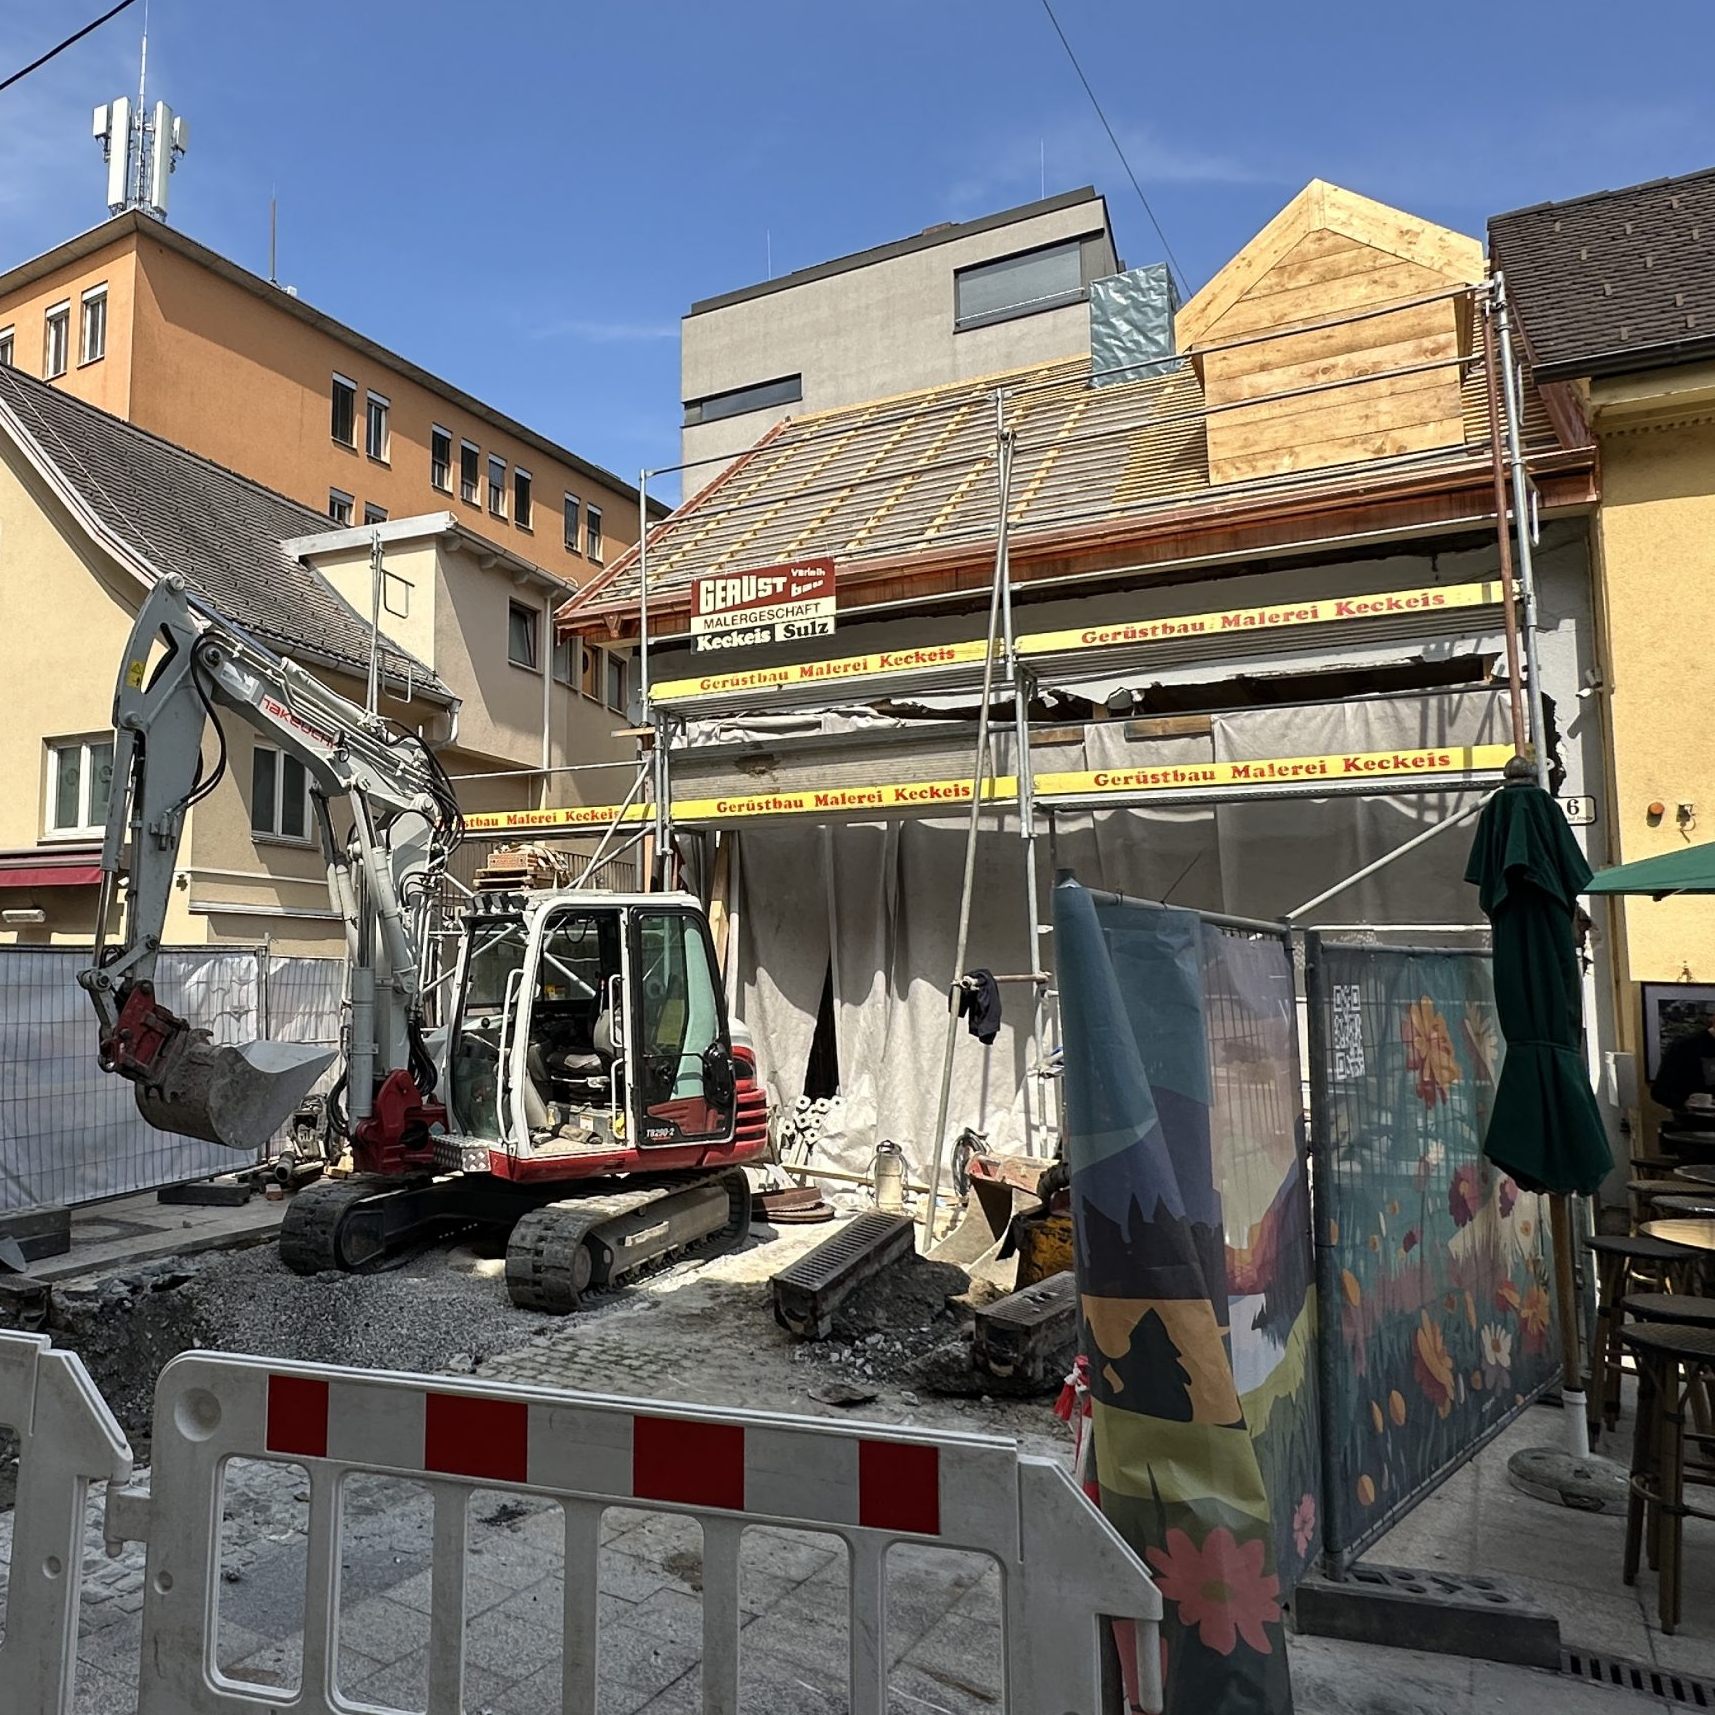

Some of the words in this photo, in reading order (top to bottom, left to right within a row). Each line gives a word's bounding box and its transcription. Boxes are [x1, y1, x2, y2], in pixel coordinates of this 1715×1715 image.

[703, 602, 821, 630] MALERGESCHÄFT
[1081, 620, 1205, 645] Gerüstbau
[1221, 605, 1319, 629] Malerei
[1335, 592, 1445, 617] Keckeis
[697, 628, 772, 652] Keckeis
[783, 620, 829, 639] Sulz
[700, 671, 789, 690] Gerüstbau
[799, 659, 868, 678] Malerei
[879, 649, 955, 669] Keckeis
[1094, 768, 1216, 787] Gerüstbau
[1231, 760, 1327, 779] Malerei
[1343, 752, 1451, 772] Keckeis
[716, 796, 804, 813] Gerüstbau
[814, 790, 883, 808] Malerei
[895, 784, 970, 801] Keckeis
[1567, 798, 1579, 815] 6
[507, 813, 557, 826] Malerei
